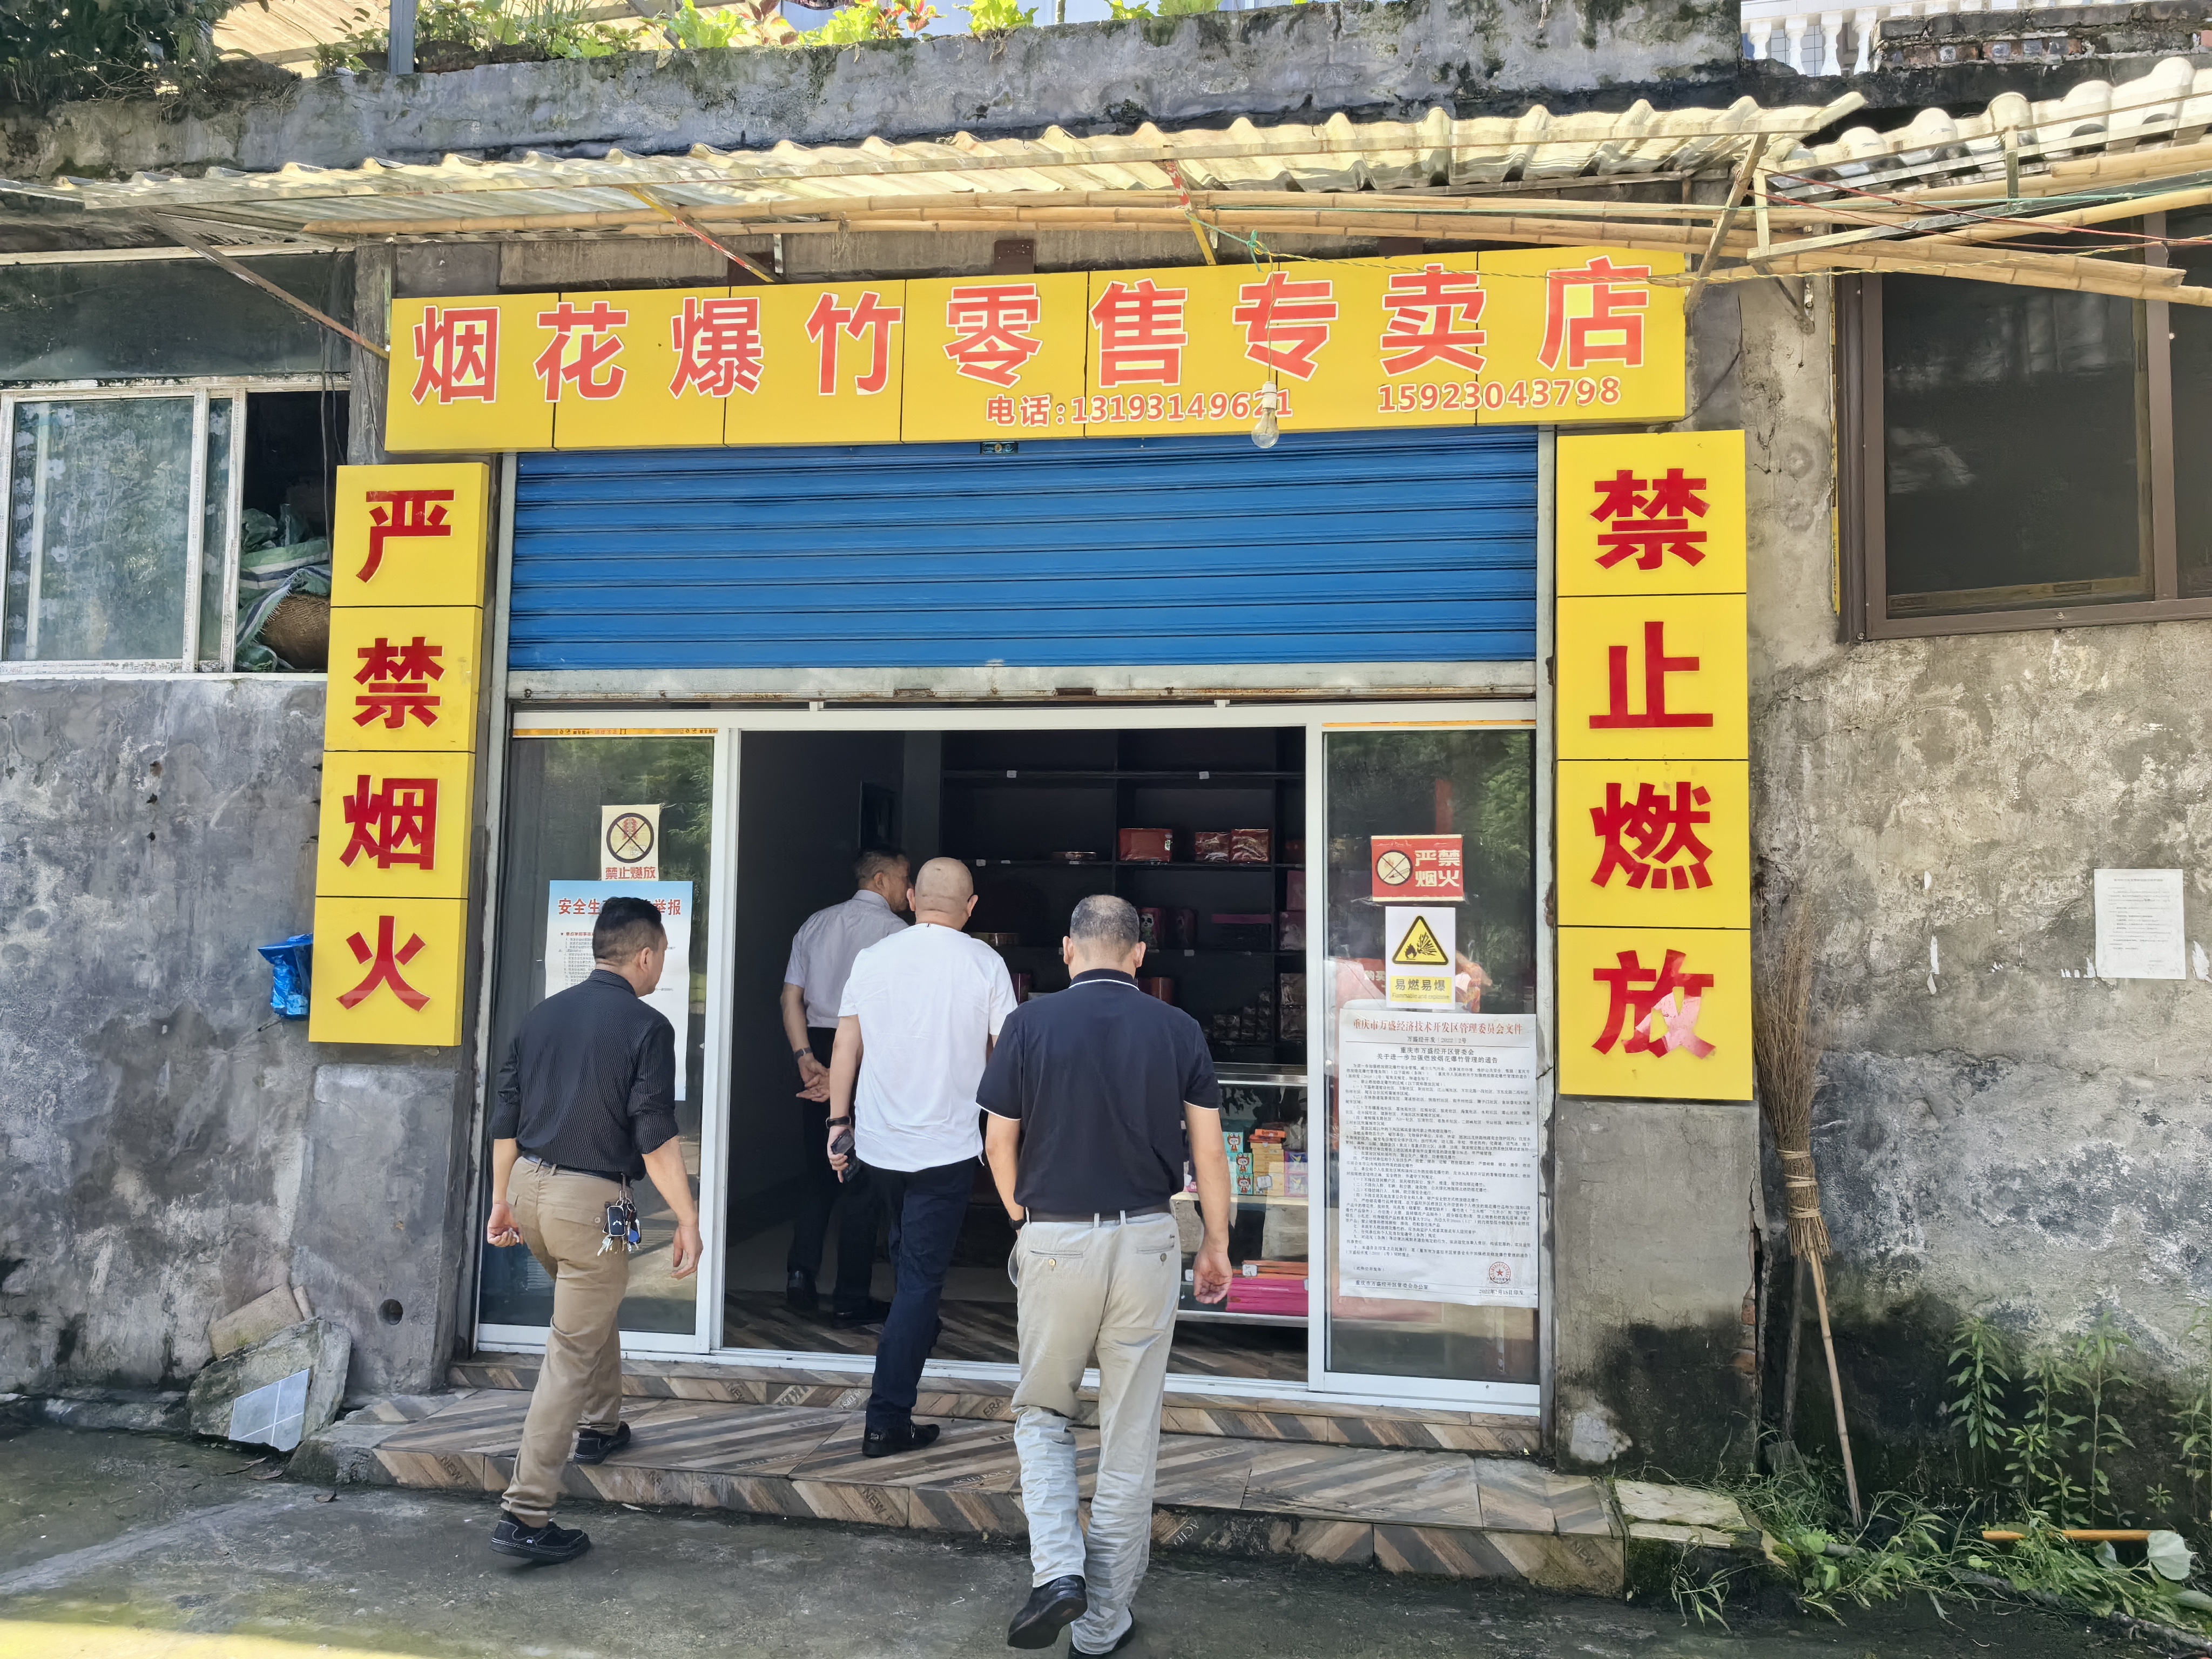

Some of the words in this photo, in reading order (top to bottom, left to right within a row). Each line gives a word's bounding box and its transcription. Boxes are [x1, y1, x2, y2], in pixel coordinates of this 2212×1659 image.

[411, 255, 1651, 405] 烟花爆竹零售专卖店
[1378, 376, 1621, 413] 15923043798
[335, 489, 456, 1013] 严禁烟火
[1589, 469, 1716, 1060] 禁止燃放
[1414, 849, 1460, 867] 严禁
[605, 866, 656, 880] 禁止燃放
[1415, 870, 1460, 887] 烟火
[1395, 979, 1445, 992] 易燃易爆
[983, 1398, 1003, 1417] ERA
[1174, 1519, 1199, 1546] ACID
